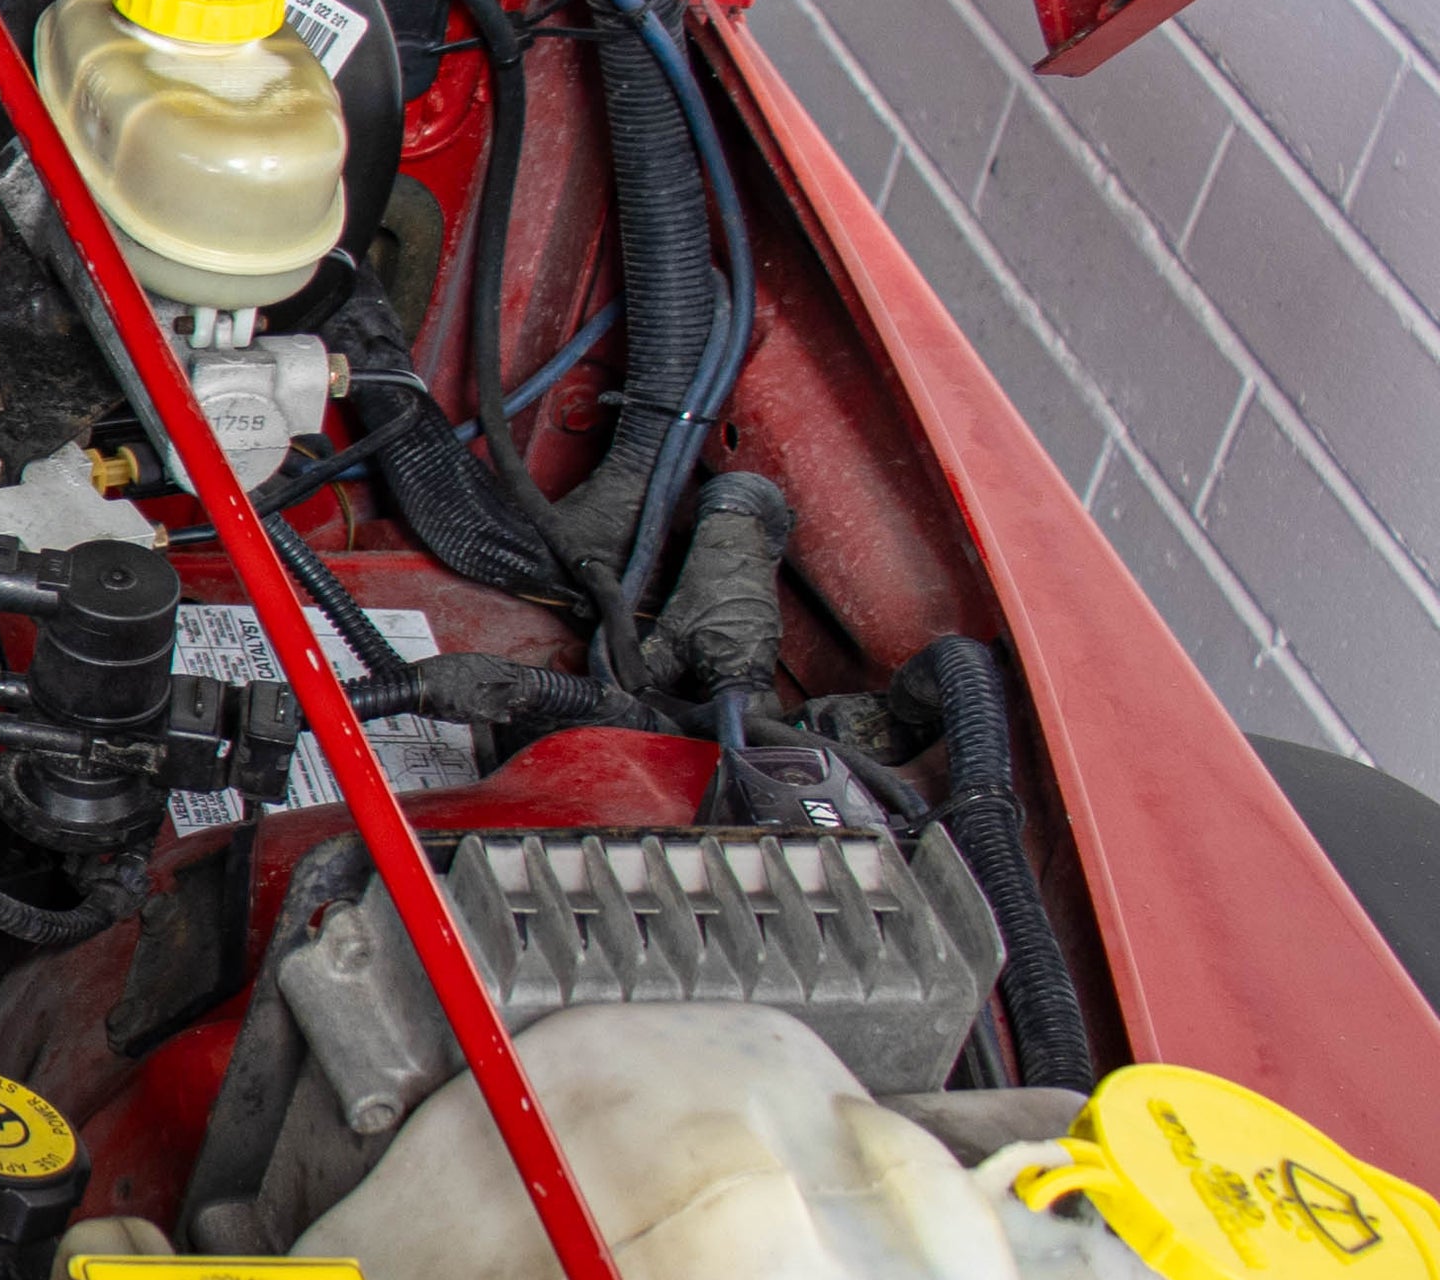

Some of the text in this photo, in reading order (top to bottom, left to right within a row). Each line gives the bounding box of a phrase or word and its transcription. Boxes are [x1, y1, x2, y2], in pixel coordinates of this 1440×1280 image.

[240, 617, 275, 679] CATALYST
[171, 792, 189, 819] VEHIC
[197, 793, 214, 823] REGULAT
[214, 792, 232, 823] CALIFORN
[26, 1096, 69, 1136] POWER
[33, 1152, 64, 1172] USE
